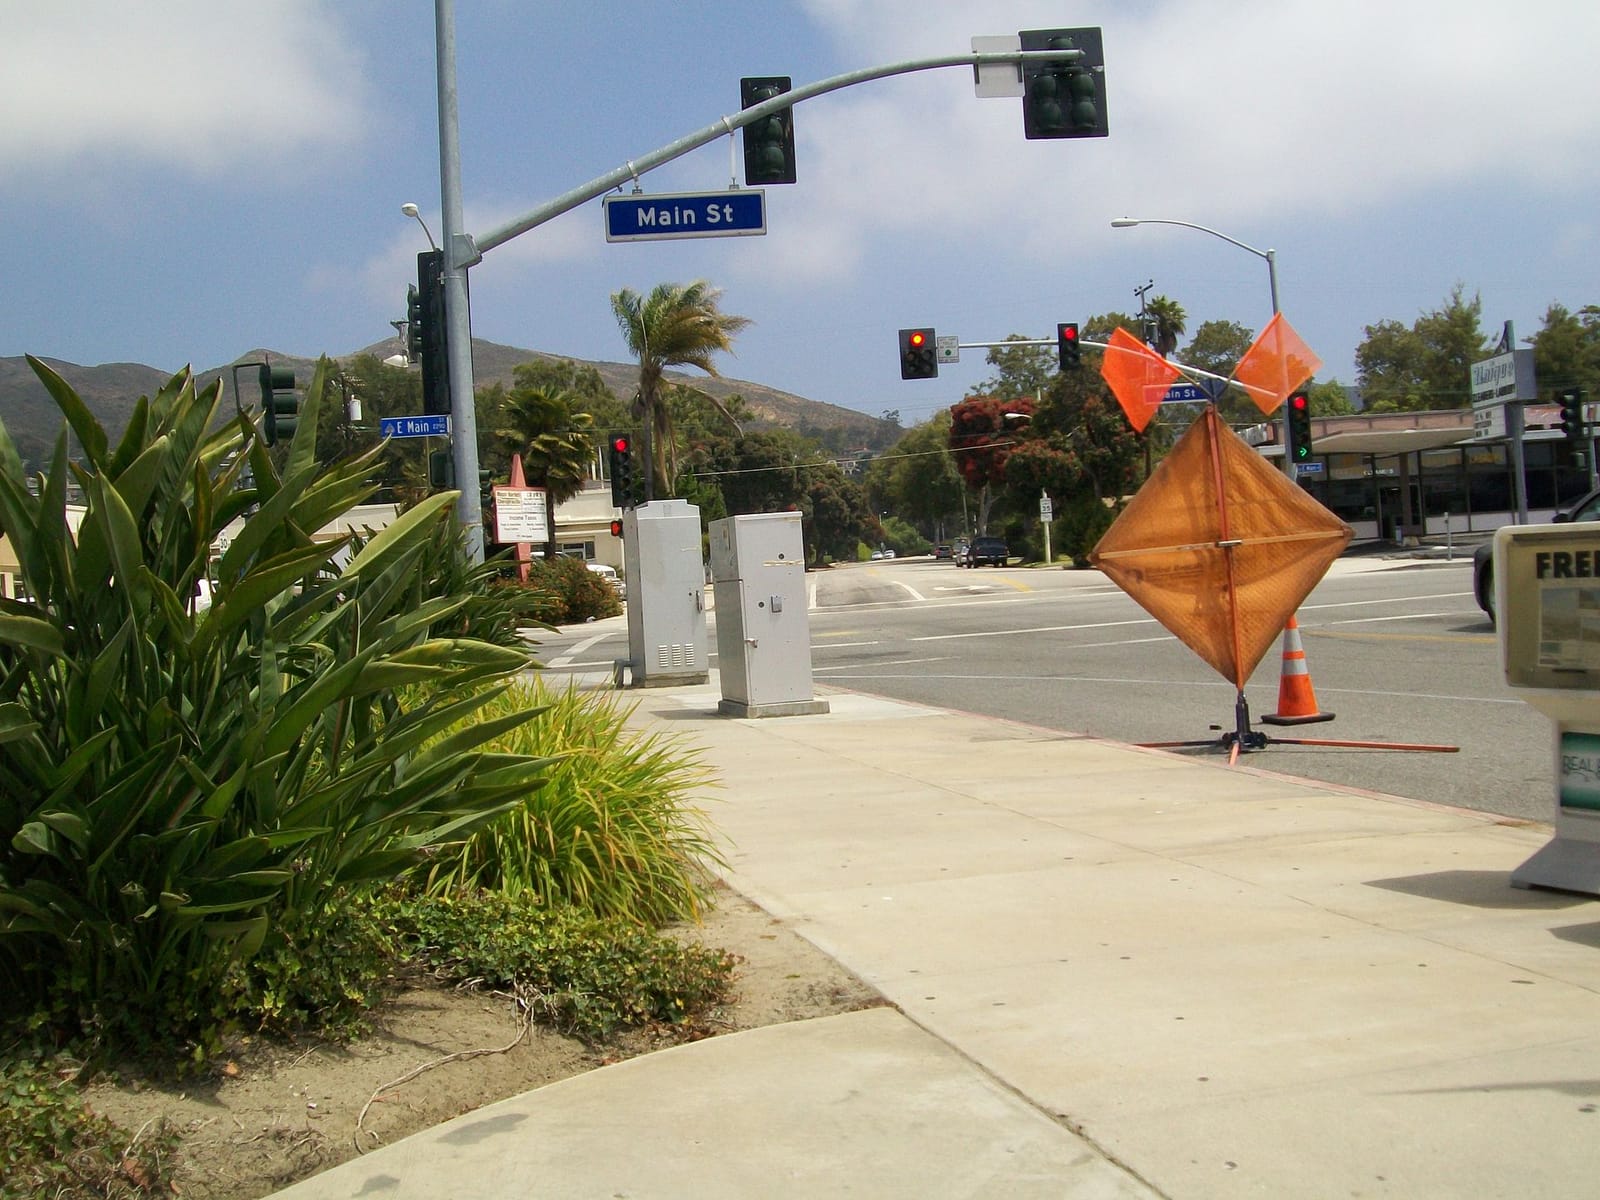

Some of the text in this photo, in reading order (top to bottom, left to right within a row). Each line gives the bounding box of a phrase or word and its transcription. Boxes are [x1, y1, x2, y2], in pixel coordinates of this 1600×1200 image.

[637, 203, 734, 227] Main St
[1183, 389, 1196, 397] St
[397, 420, 429, 433] E Main
